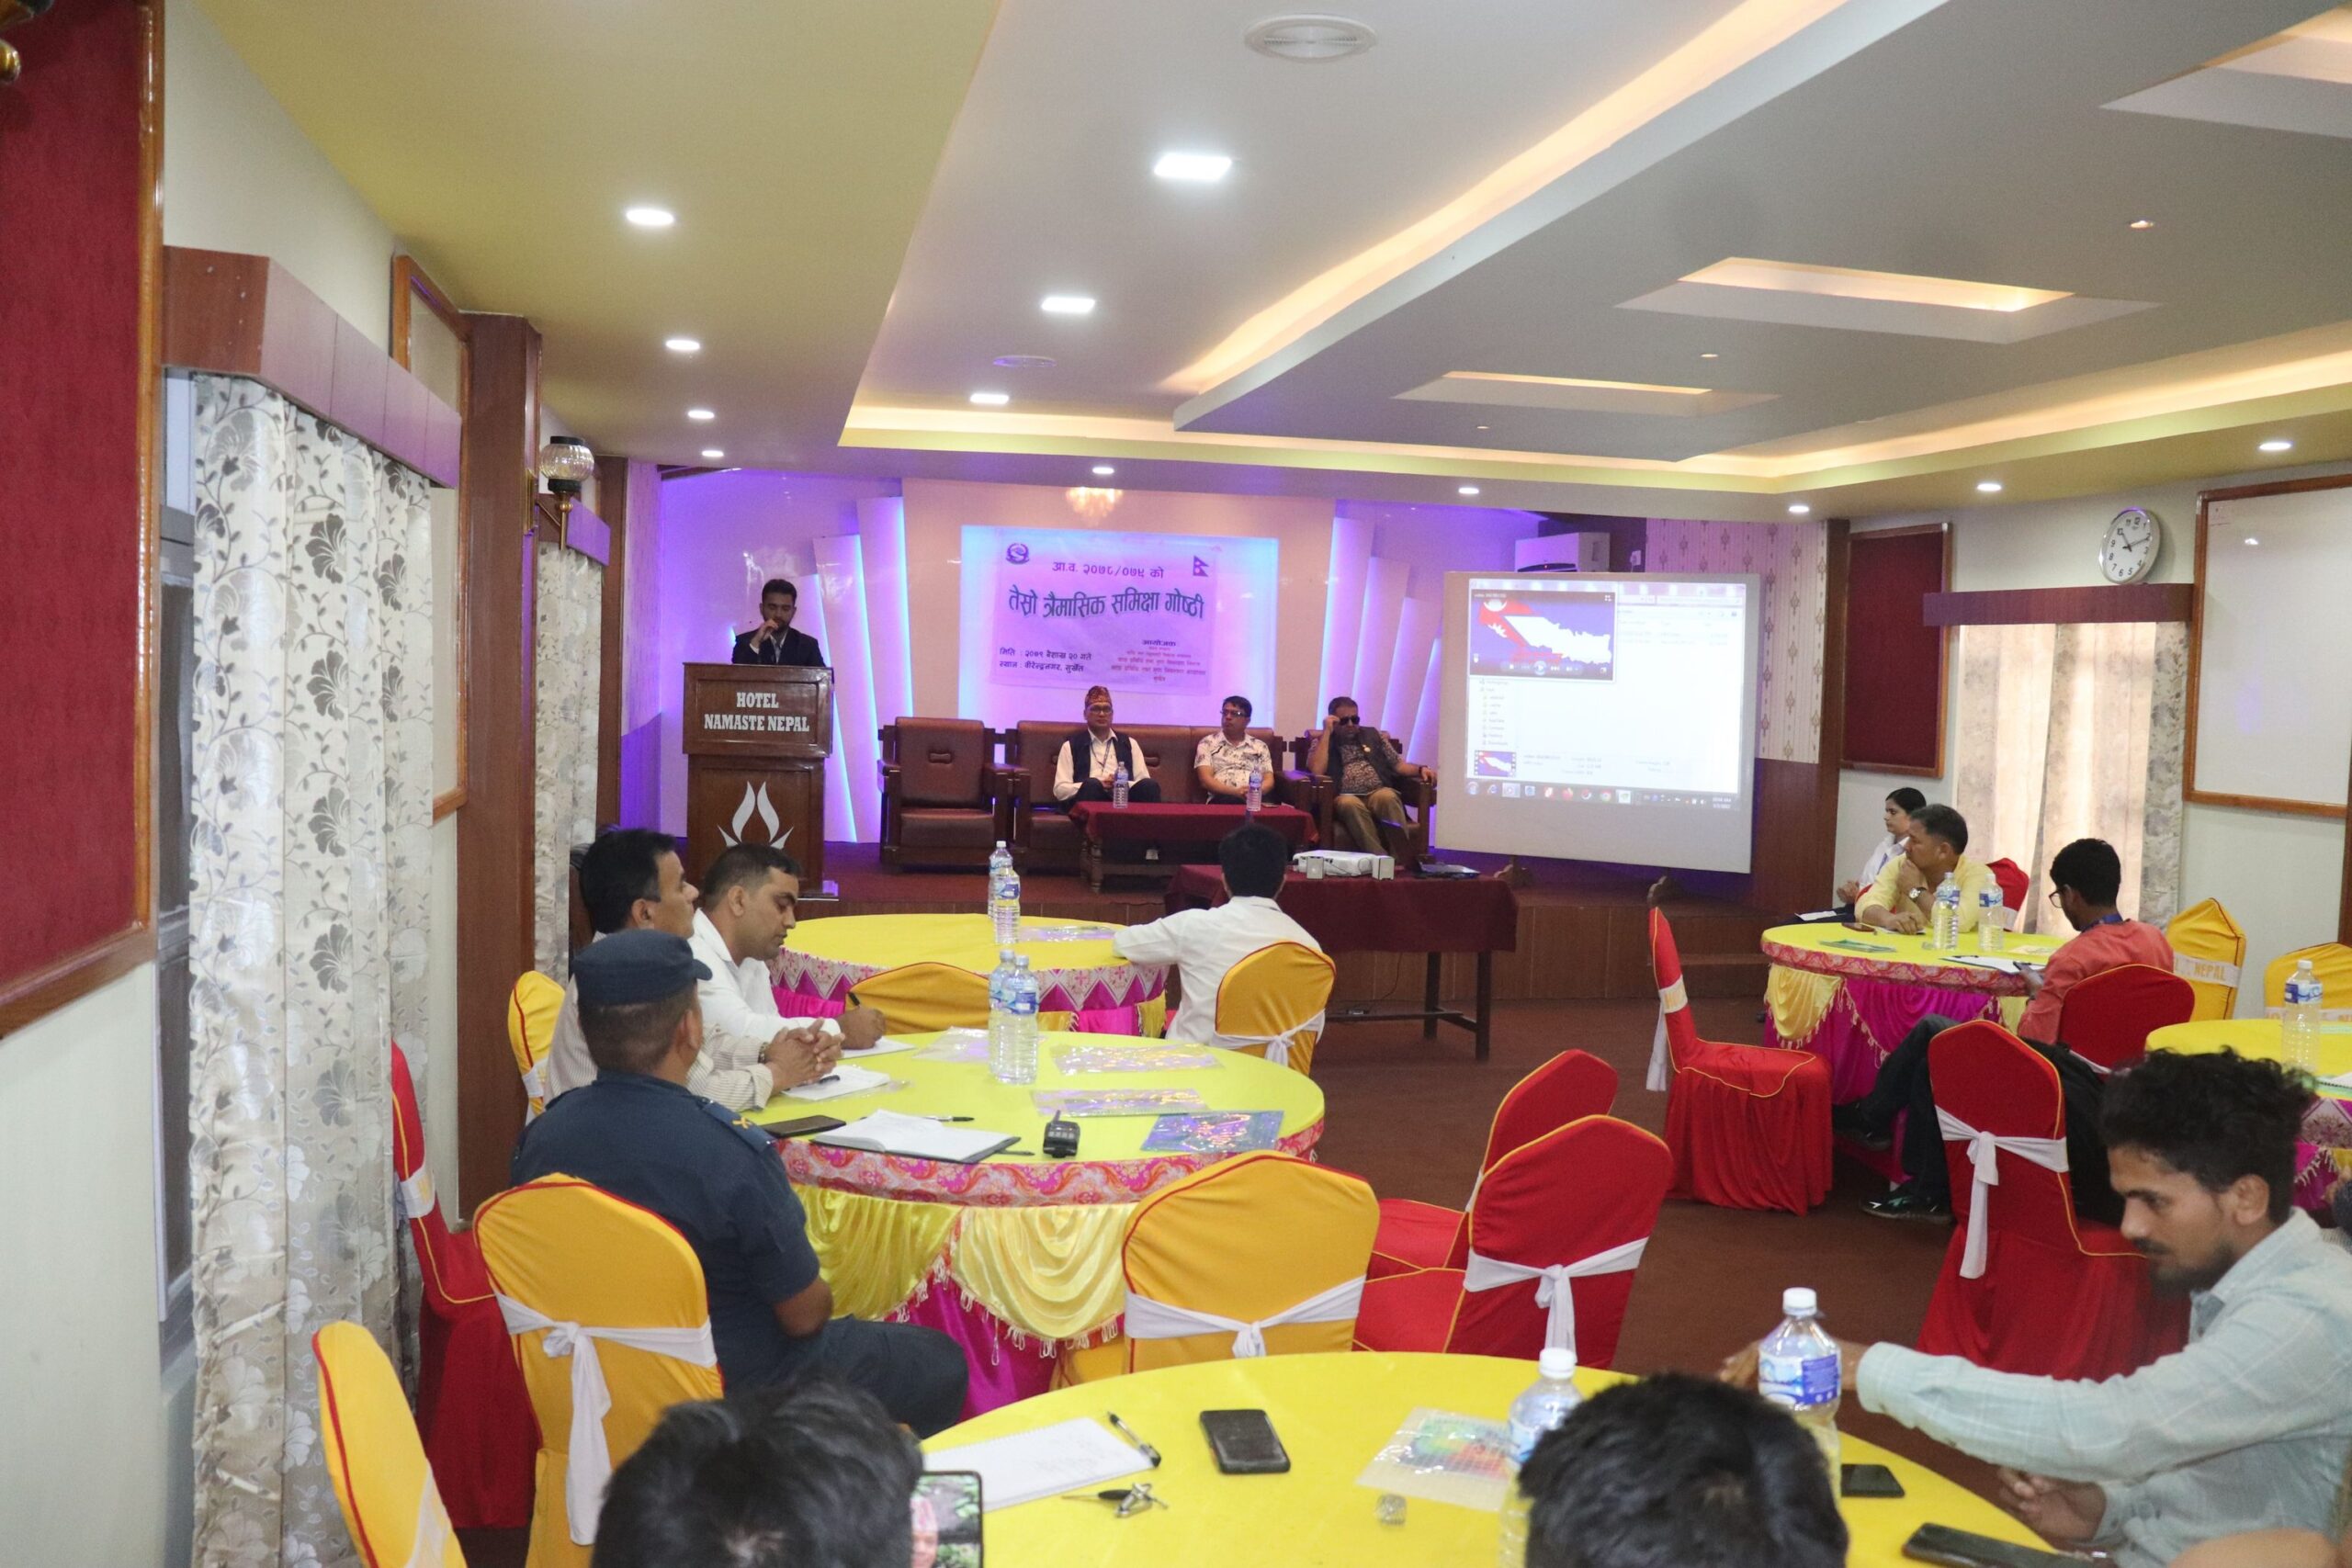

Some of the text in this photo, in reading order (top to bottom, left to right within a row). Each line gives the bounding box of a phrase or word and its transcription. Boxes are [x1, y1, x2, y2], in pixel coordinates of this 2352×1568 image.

[1149, 566, 1164, 579] को
[1043, 591, 1106, 618] त्रैमासिक
[1111, 586, 1159, 615] समिक्षा
[1165, 588, 1204, 619] गोष्ठी
[736, 692, 779, 708] HOTEL
[704, 714, 810, 732] NAMASTE NEPAL
[2194, 961, 2226, 981] NEPAL
